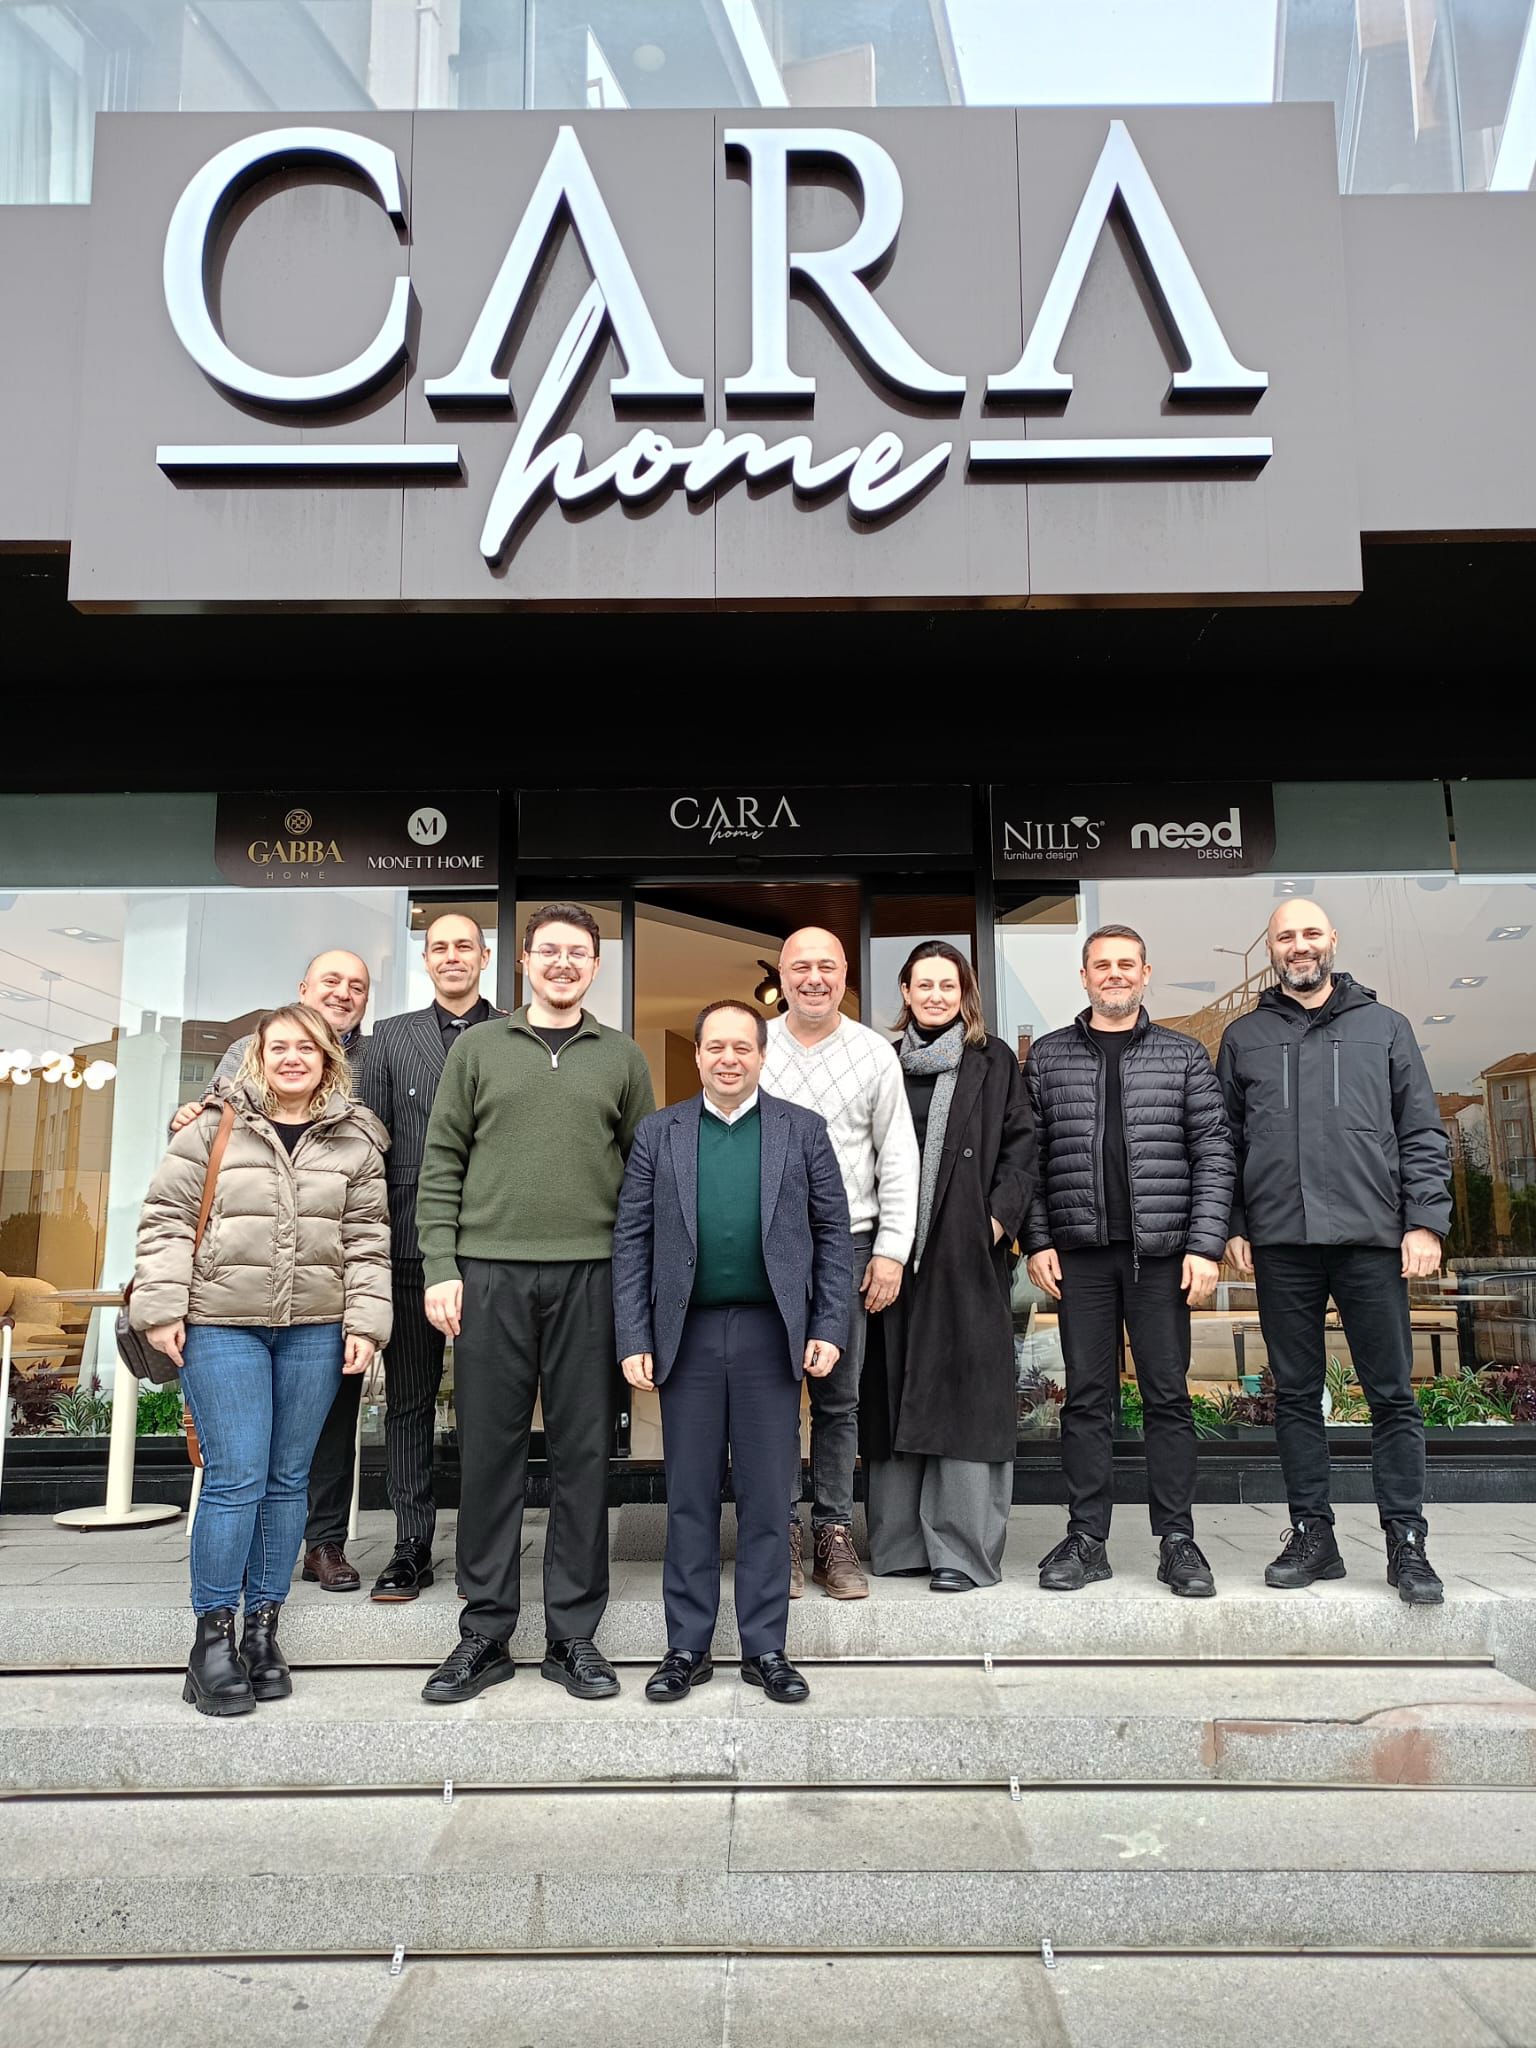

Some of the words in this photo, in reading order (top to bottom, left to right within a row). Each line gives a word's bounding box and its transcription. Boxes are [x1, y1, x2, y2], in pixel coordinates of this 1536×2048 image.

[163, 120, 1270, 404] CARA
[479, 279, 953, 565] home
[669, 795, 801, 830] CARA
[708, 814, 764, 845] home
[1131, 807, 1242, 849] need
[247, 839, 345, 867] GABBA
[367, 855, 434, 870] MONETT
[437, 855, 485, 870] HOME
[1003, 850, 1043, 861] furniture
[1046, 850, 1079, 862] design
[1197, 848, 1243, 860] DESIGN
[266, 871, 326, 880] HOME
